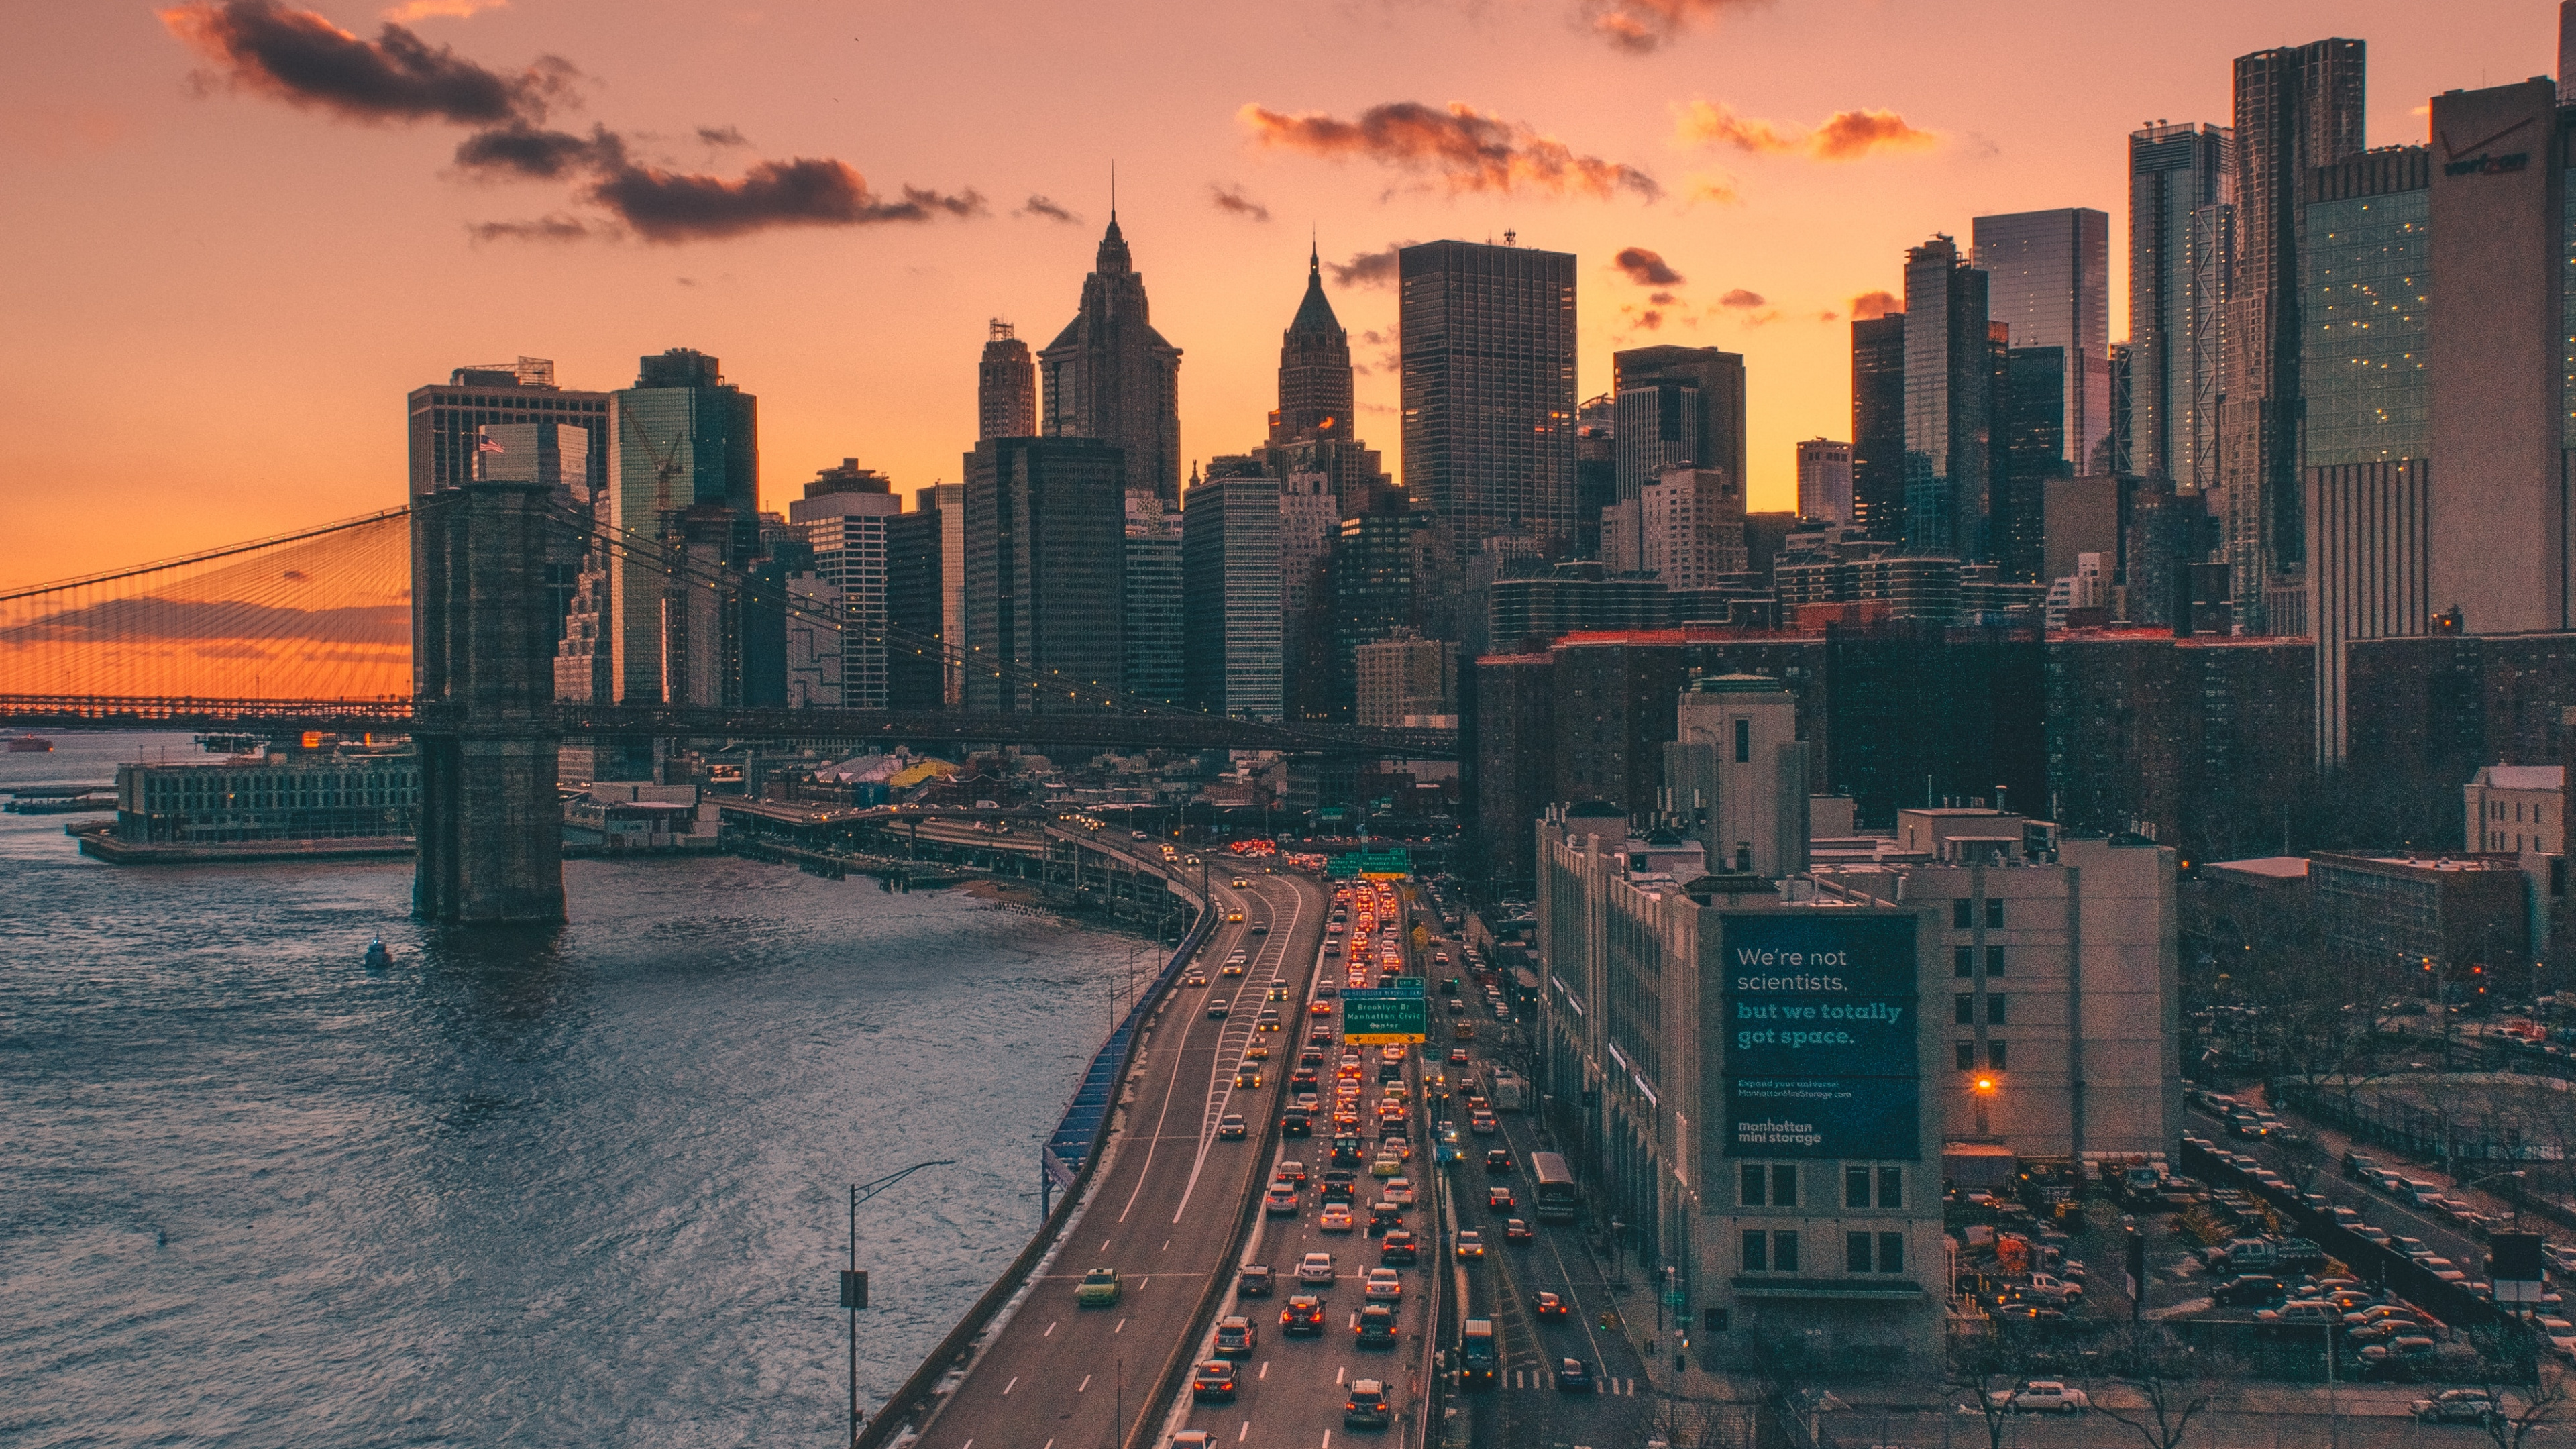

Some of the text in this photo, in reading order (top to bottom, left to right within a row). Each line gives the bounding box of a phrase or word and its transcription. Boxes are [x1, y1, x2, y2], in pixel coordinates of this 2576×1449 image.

[1737, 948, 1847, 966] We're not
[1357, 1004, 1397, 1012] Brooklyn
[1737, 1003, 1902, 1024] but we totally
[1738, 1028, 1854, 1050] got space.
[1738, 1079, 1772, 1089] Expand
[1774, 1081, 1794, 1089] your
[1738, 1118, 1813, 1132] manhattan
[1738, 1132, 1821, 1146] mini storage
